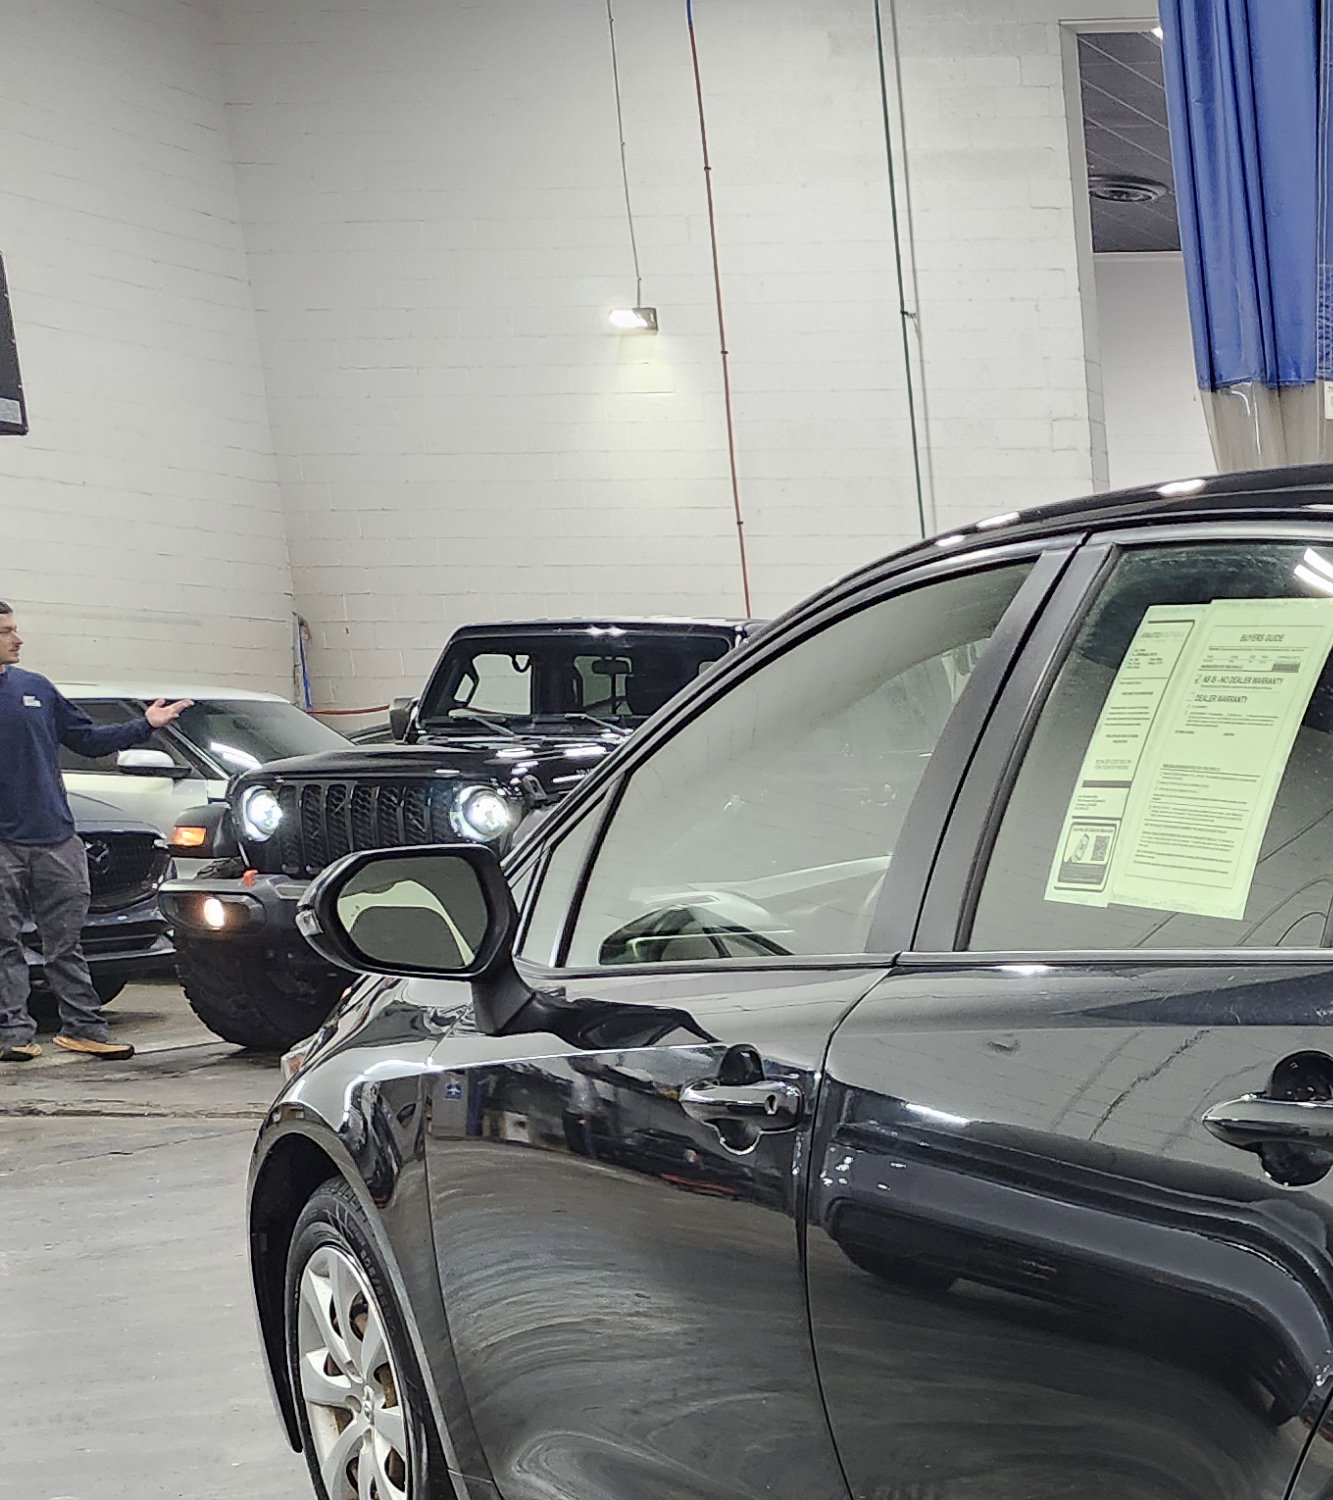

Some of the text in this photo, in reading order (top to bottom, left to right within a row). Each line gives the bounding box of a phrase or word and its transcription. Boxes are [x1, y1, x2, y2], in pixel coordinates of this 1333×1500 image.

[1229, 676, 1252, 685] DEALER
[1252, 676, 1284, 686] WARRANTY
[1195, 694, 1248, 704] DEALER WARRANTY
